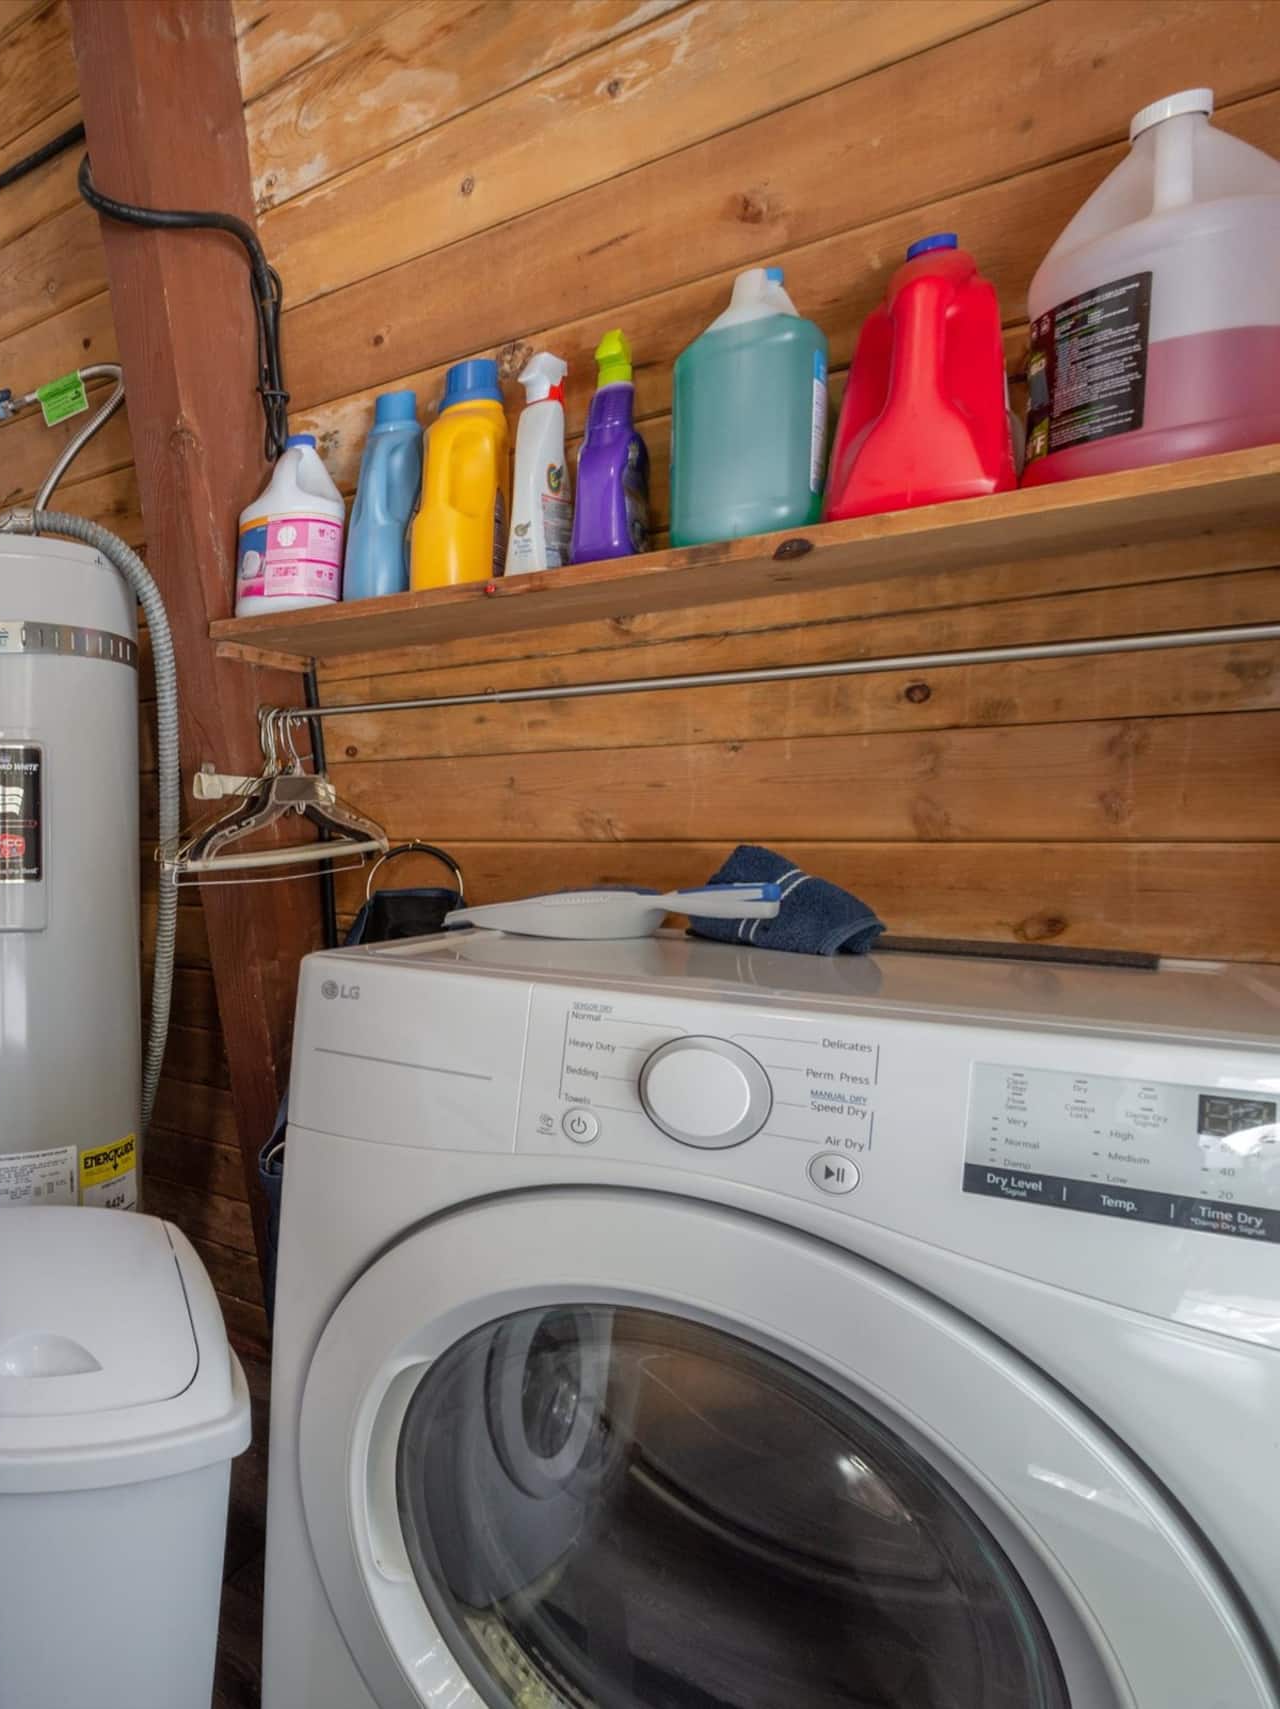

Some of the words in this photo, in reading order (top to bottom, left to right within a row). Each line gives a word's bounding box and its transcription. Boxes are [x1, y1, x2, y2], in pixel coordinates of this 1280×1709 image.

[14, 762, 39, 771] WHITE
[340, 984, 361, 1000] LG
[571, 1010, 602, 1021] Normal
[568, 1037, 594, 1050] Heavy
[595, 1041, 617, 1053] Duty
[822, 1038, 873, 1053] Delicates
[566, 1064, 599, 1080] Bedding
[839, 1072, 870, 1085] Press
[564, 1092, 592, 1104] Towels
[811, 1101, 845, 1115] Speed
[847, 1105, 868, 1119] Dry
[1007, 1116, 1028, 1128] Very
[1109, 1129, 1134, 1141] High
[825, 1136, 842, 1147] Air
[844, 1139, 865, 1152] Dry
[1004, 1137, 1040, 1150] Normal
[1003, 1158, 1031, 1170] Damp
[1108, 1151, 1150, 1165] Medium
[1219, 1167, 1236, 1177] 40
[986, 1172, 1008, 1187] Dry
[1011, 1176, 1043, 1192] Level
[1218, 1190, 1234, 1201] 20
[1101, 1194, 1138, 1213] Temp.
[1200, 1205, 1233, 1222] Time
[1237, 1211, 1264, 1228] Dry
